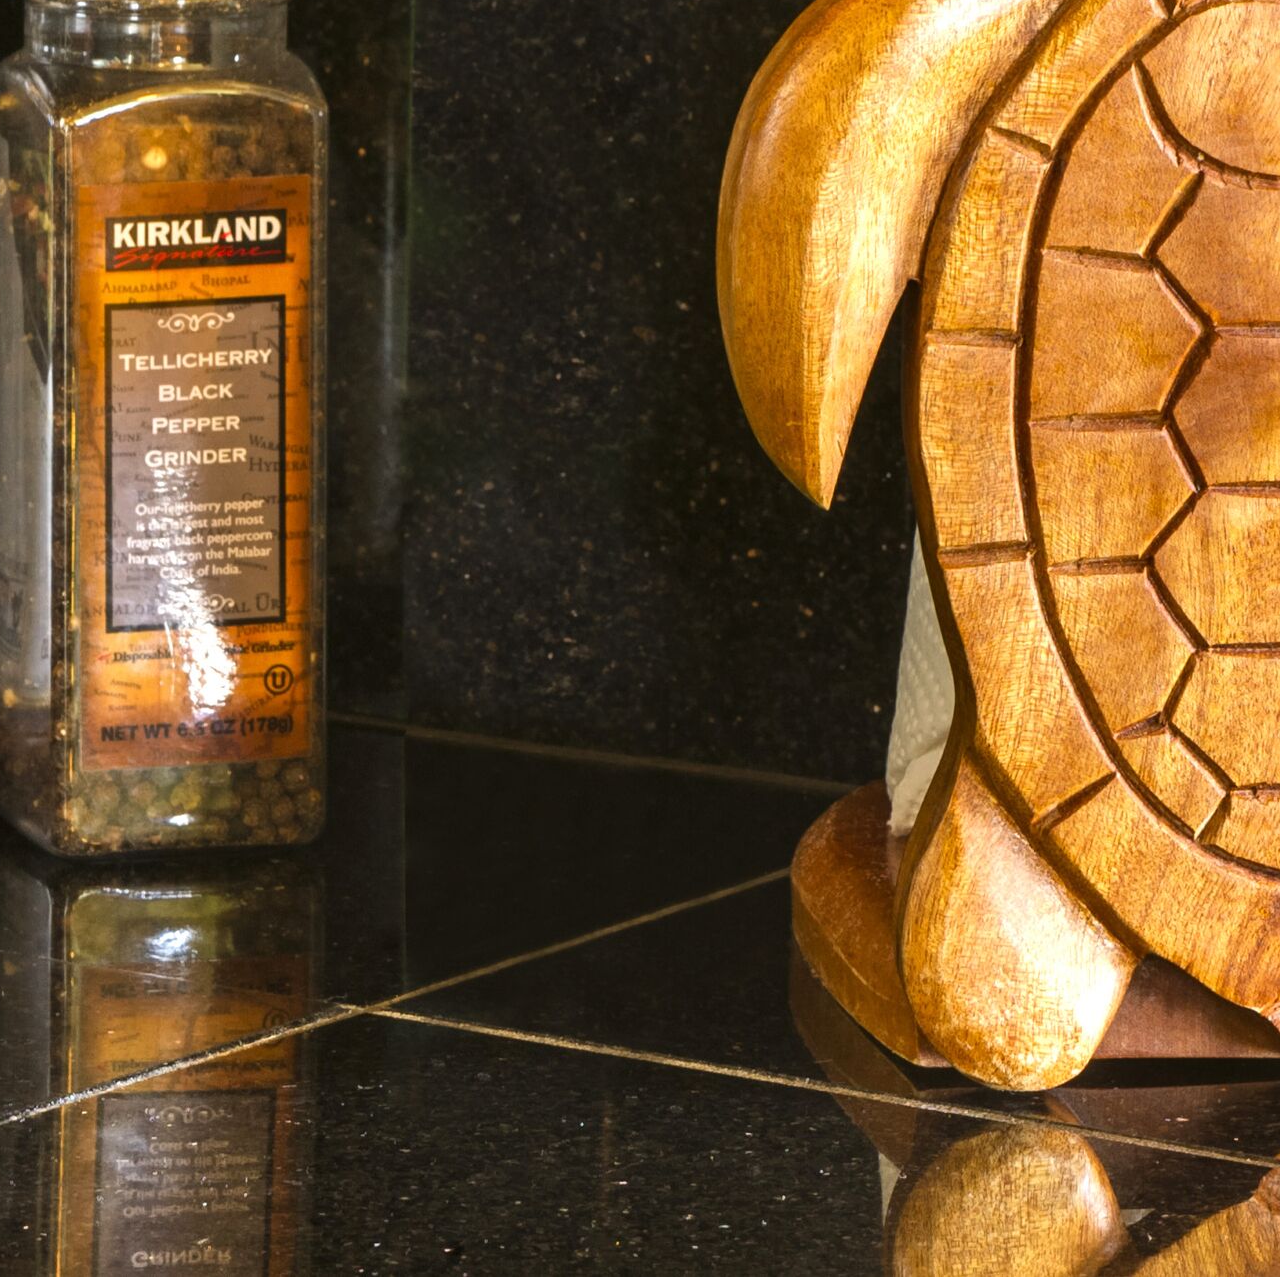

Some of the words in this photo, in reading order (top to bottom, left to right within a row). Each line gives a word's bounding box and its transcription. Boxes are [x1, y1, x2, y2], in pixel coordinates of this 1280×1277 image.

[113, 215, 282, 249] KIRKLAND
[113, 244, 282, 270] Signature
[119, 349, 271, 372] TELLICHERRY
[158, 383, 233, 403] BLACK
[152, 416, 240, 435] PEPPER
[145, 448, 247, 468] GRINDER
[224, 499, 264, 512] pepper
[212, 515, 232, 527] and
[235, 515, 264, 526] most
[174, 533, 204, 546] black
[207, 531, 273, 548] peppercorn
[188, 551, 202, 560] on
[205, 548, 224, 559] the
[228, 546, 272, 559] Malabar
[197, 566, 209, 577] of
[212, 564, 242, 575] India.
[251, 641, 295, 653] Grinder
[113, 650, 172, 664] Disposabl
[101, 726, 138, 741] NET
[143, 724, 171, 739] WT
[210, 720, 235, 734] OZ
